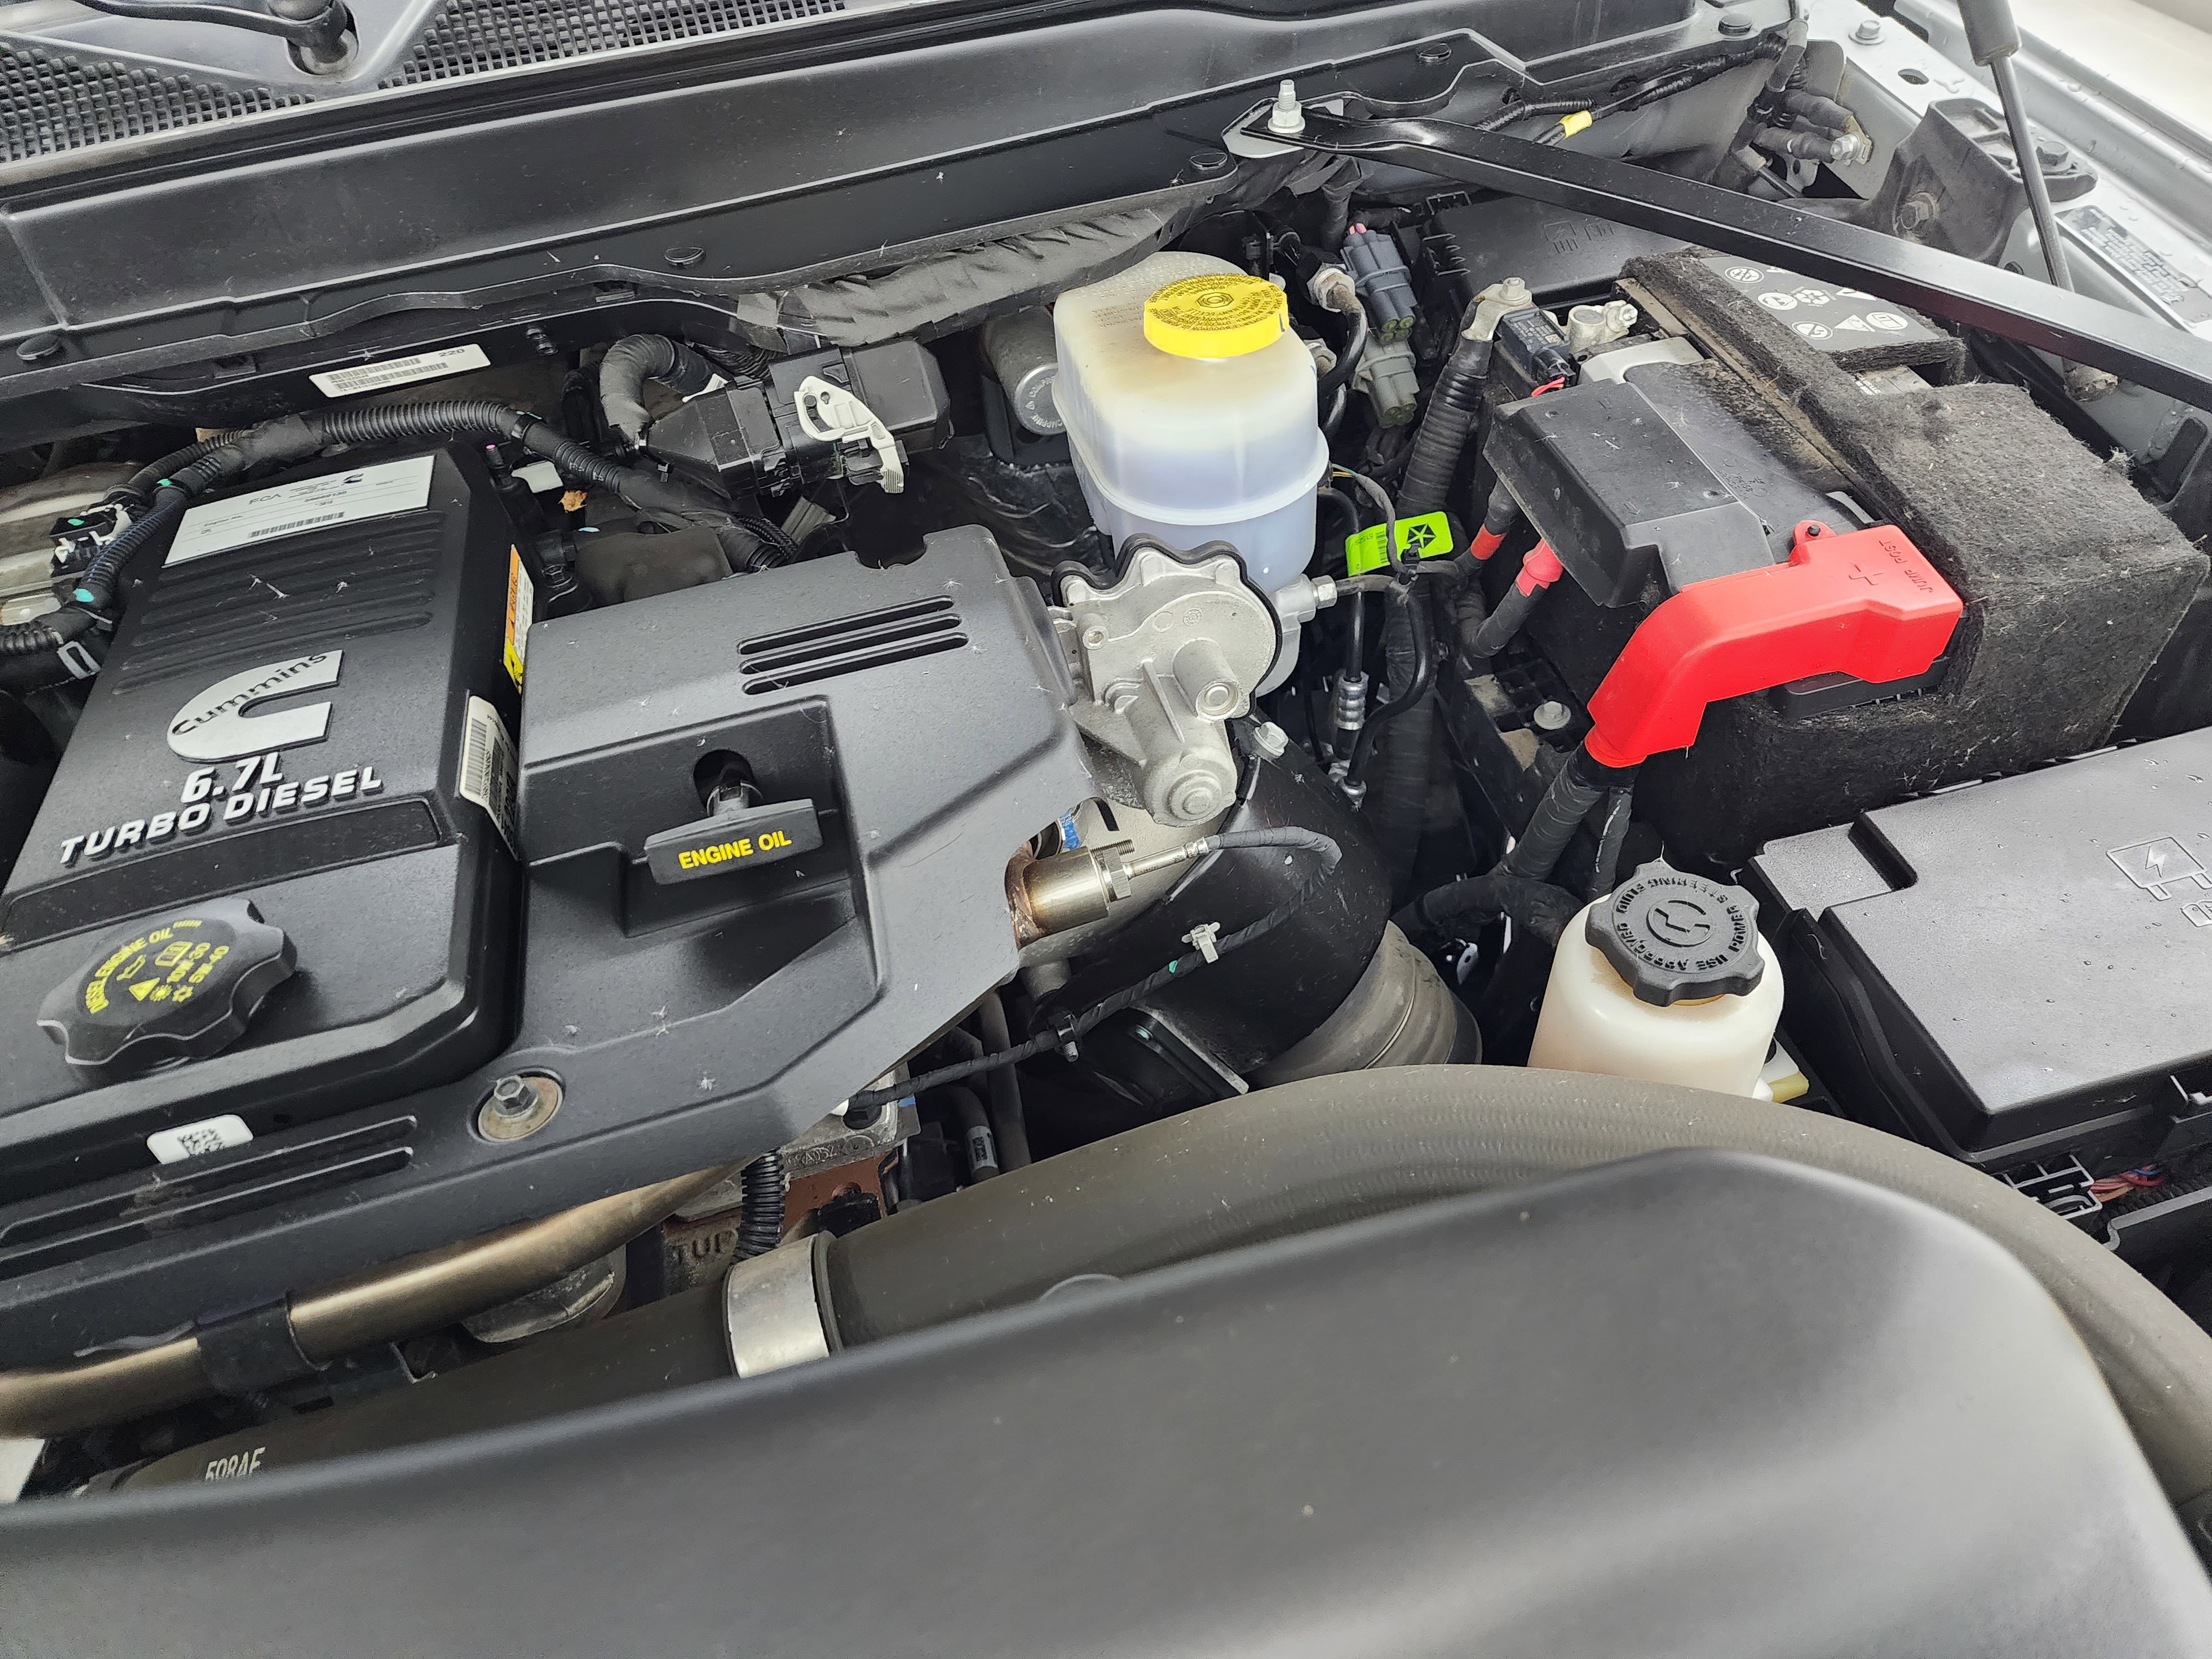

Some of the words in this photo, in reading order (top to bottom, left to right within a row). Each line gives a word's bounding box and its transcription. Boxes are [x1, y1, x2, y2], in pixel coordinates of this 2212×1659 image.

[438, 348, 465, 357] 220
[248, 492, 281, 505] FCA
[1879, 540, 1908, 564] POST
[1904, 569, 1934, 593] JUMP
[172, 654, 327, 735] Cummins
[181, 752, 284, 804] 6.7L
[59, 802, 211, 864] TURBO
[223, 766, 383, 821] DIESEL
[678, 838, 754, 869] ENGINE
[758, 830, 792, 851] OIL
[1616, 883, 1647, 914] FLUID
[1647, 877, 1729, 904] STEERING
[1616, 922, 1690, 971] APPROVED
[1726, 904, 1747, 953] POWER
[94, 937, 148, 978] ENGINE
[148, 927, 174, 944] OIL
[188, 945, 230, 984] 5W-40
[1695, 954, 1729, 971] USE
